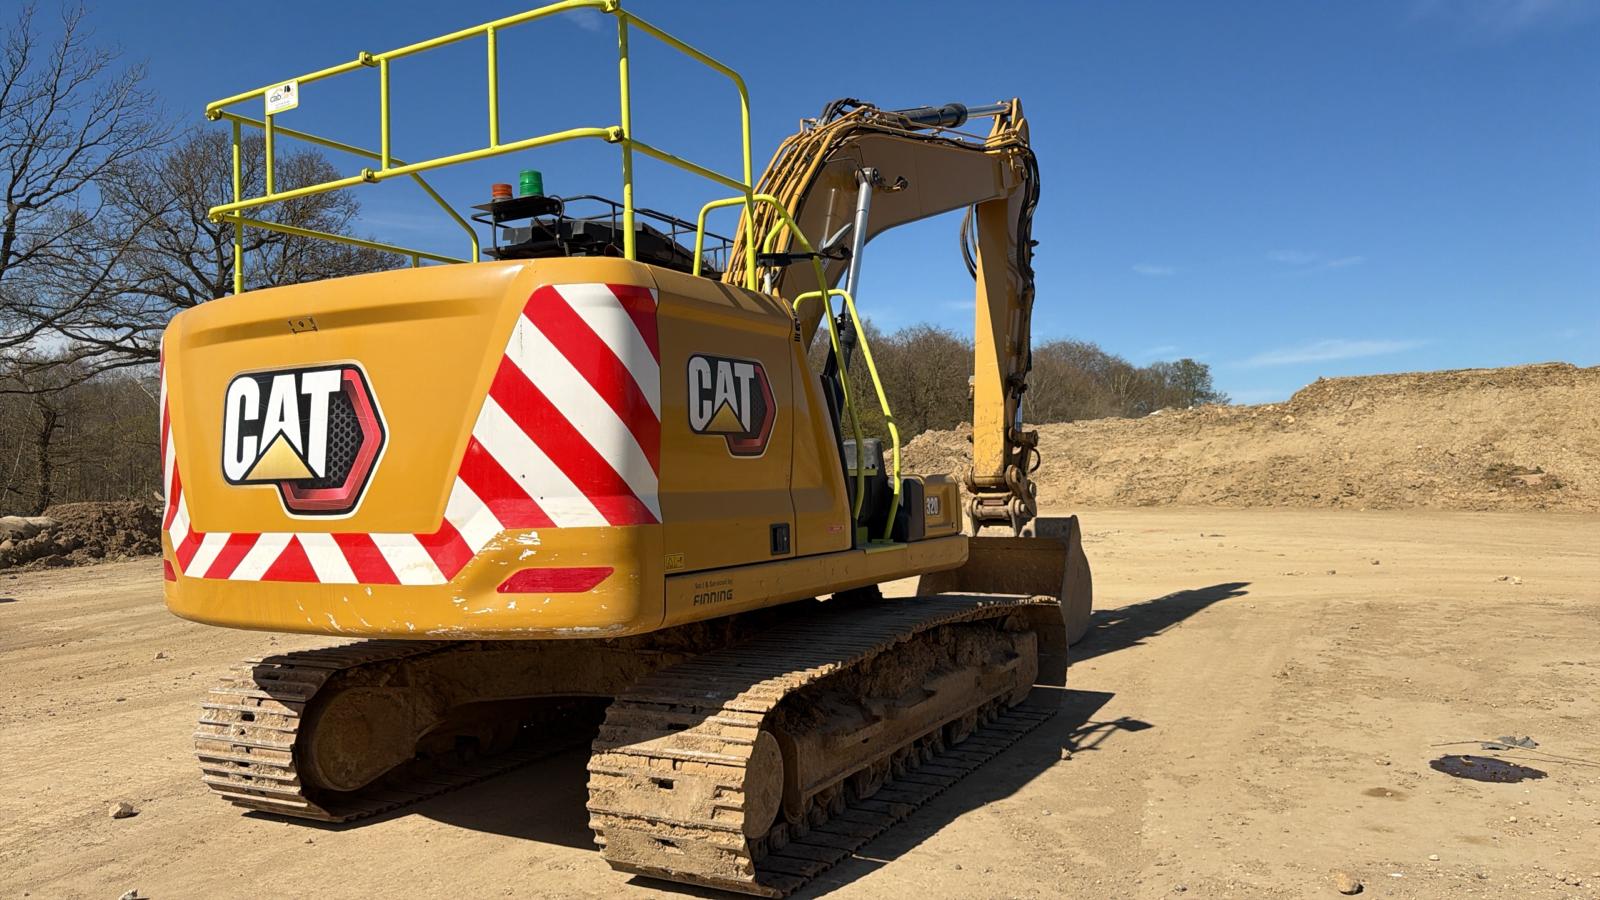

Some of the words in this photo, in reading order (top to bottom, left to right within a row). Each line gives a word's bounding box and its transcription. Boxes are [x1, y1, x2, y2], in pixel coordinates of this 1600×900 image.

[688, 356, 755, 433] CAT
[223, 369, 342, 481] CAT
[926, 497, 939, 514] 320
[693, 589, 733, 606] FINNING
